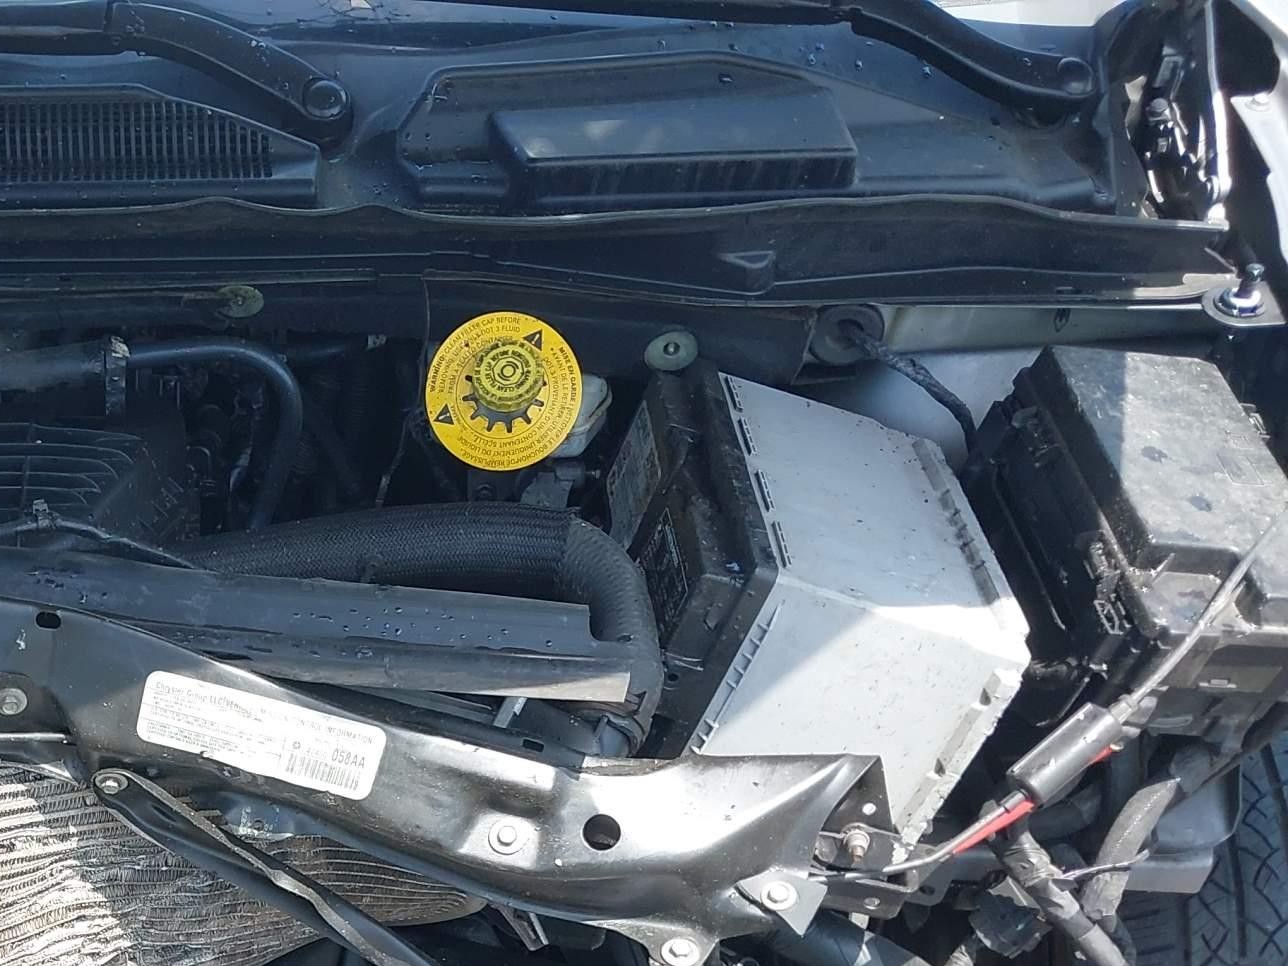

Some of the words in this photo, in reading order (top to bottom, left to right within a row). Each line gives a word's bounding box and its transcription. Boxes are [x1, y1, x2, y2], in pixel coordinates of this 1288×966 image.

[444, 333, 464, 354] CLEAN
[481, 319, 494, 327] CAP
[481, 327, 493, 336] DOT
[502, 325, 520, 333] FLUID
[552, 352, 565, 371] AVANT
[559, 347, 571, 364] MISE
[567, 365, 575, 375] EN
[448, 374, 456, 393] FROM
